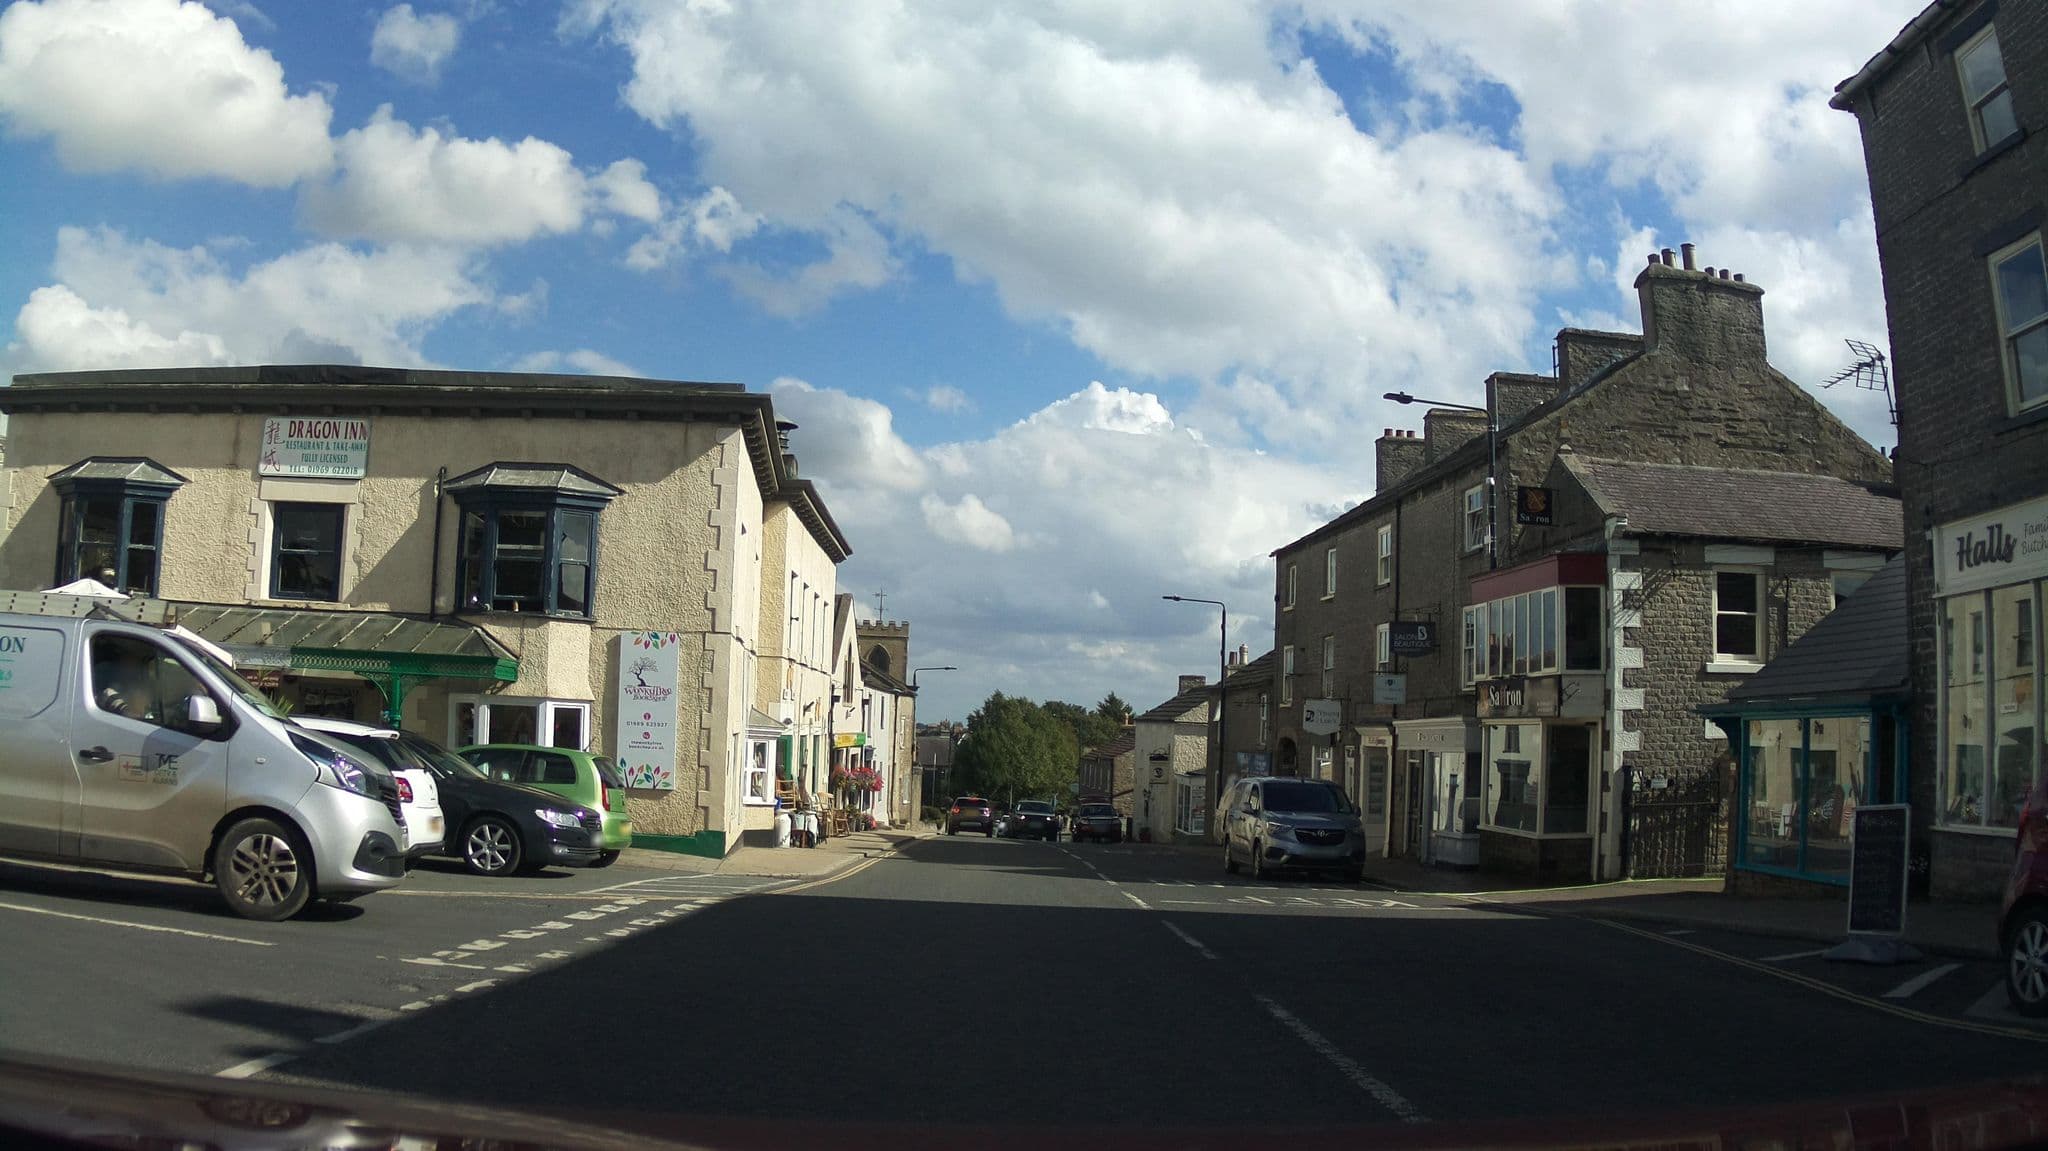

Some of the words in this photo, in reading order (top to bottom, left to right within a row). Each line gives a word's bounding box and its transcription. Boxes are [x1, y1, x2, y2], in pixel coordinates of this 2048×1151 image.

[288, 420, 341, 439] DRAGON
[344, 421, 368, 441] INN
[286, 440, 324, 451] RESTAURANT
[301, 453, 318, 463] FULLY
[320, 454, 349, 464] LICENSED
[307, 465, 330, 474] 01969
[1956, 523, 2017, 572] Halls
